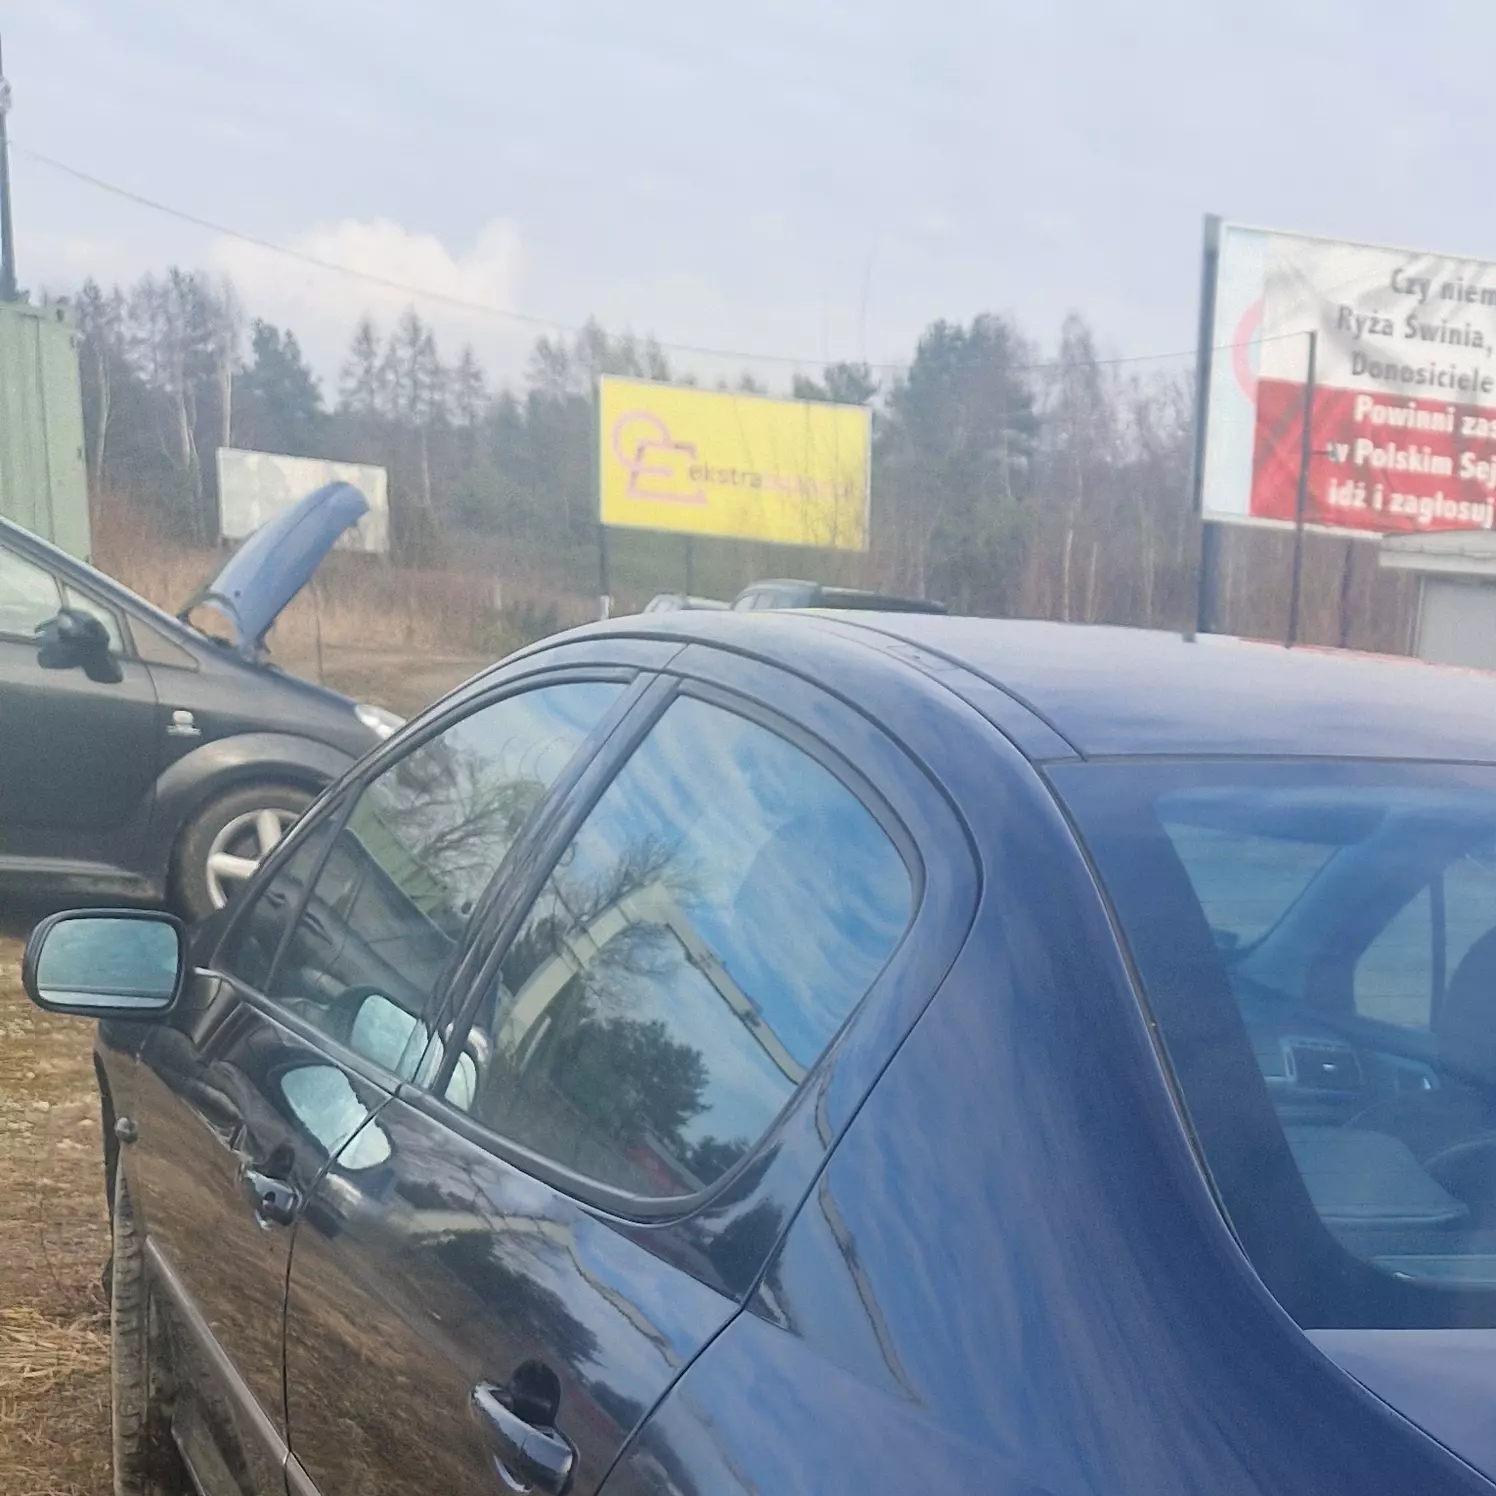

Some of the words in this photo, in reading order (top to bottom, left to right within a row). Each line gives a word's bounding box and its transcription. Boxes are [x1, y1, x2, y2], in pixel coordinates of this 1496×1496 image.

[1391, 268, 1430, 304] Czy
[1338, 305, 1394, 339] Ryża
[1352, 350, 1493, 393] Donosiciele
[1354, 395, 1455, 433] Powinni
[1354, 438, 1453, 475] Polskim
[1374, 484, 1384, 510] i
